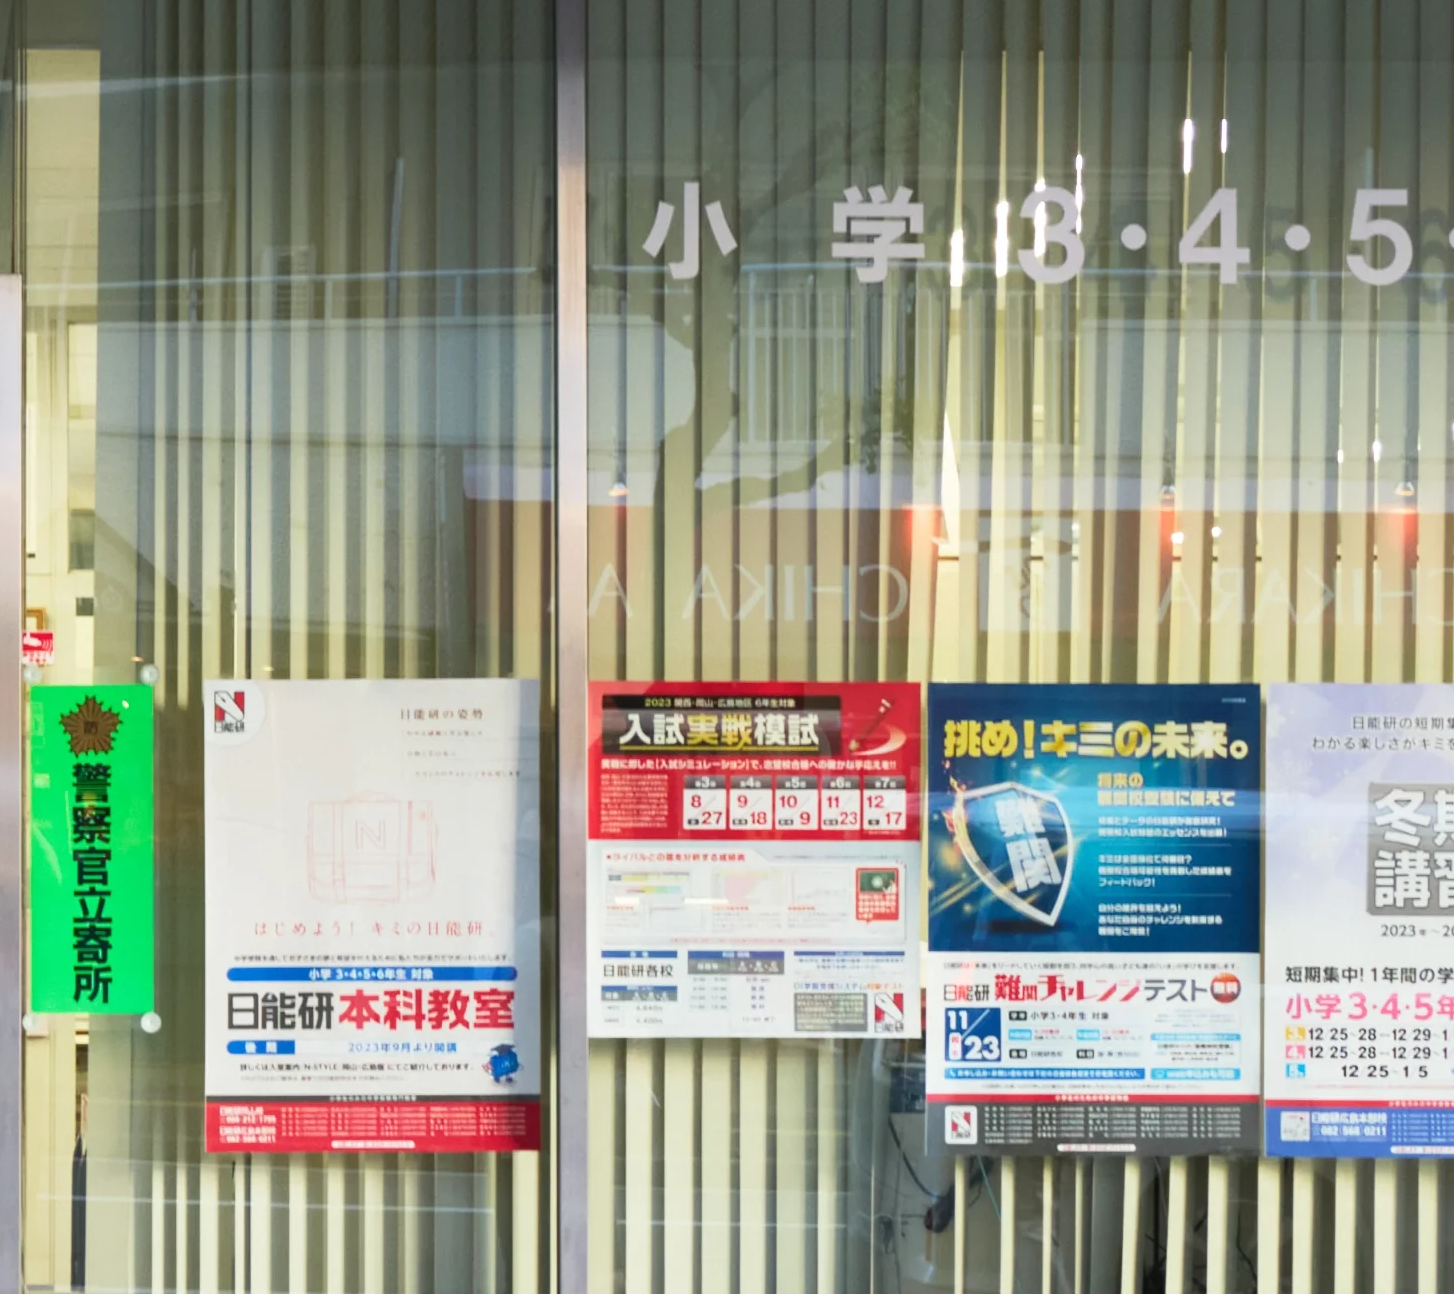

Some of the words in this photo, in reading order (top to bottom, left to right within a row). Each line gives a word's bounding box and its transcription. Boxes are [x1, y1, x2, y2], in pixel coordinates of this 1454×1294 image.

[644, 698, 672, 708] 2023
[213, 722, 245, 733] 日能研
[618, 711, 820, 747] 入試実戦模試
[943, 719, 1250, 760] 挑め!キミの未来。
[71, 762, 113, 1004] 警察官立寄所
[943, 983, 991, 1002] 日能研
[227, 988, 515, 1031] 日能研本科教室
[946, 1010, 968, 1030] 11
[963, 1034, 1001, 1060] 23
